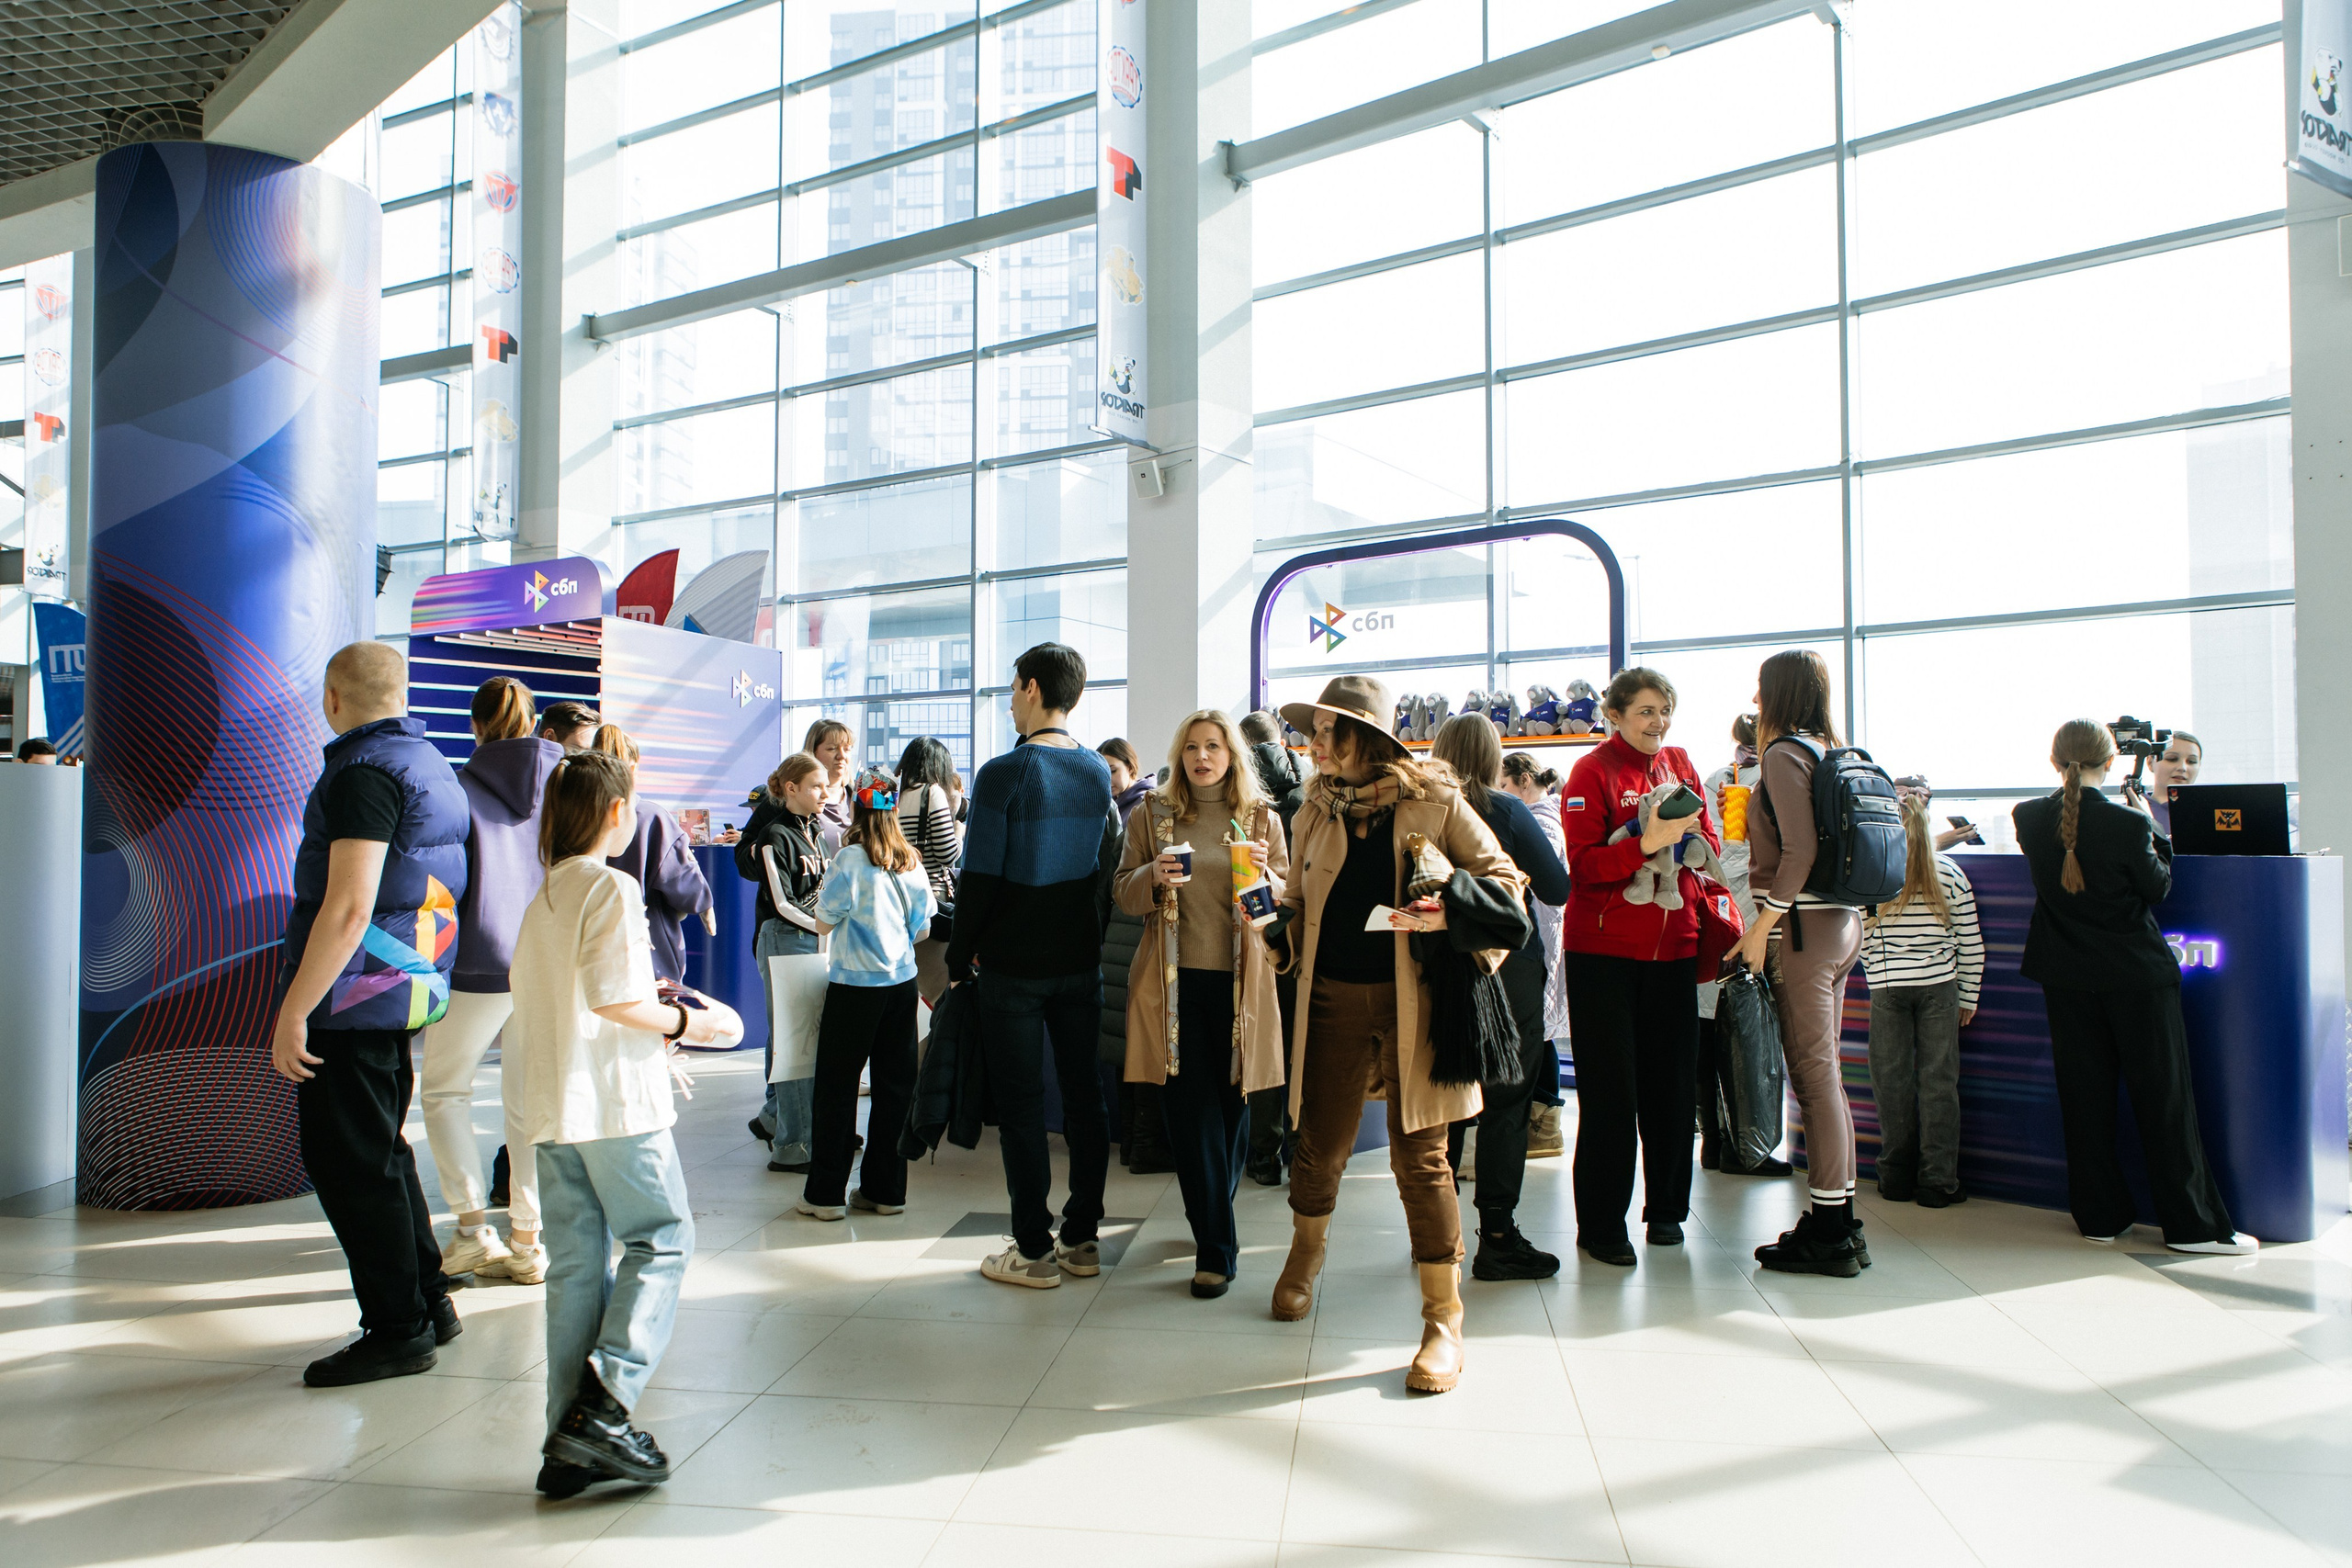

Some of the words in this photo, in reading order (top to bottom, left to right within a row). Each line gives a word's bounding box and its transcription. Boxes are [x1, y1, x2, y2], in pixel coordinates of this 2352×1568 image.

[550, 578, 578, 596] сбп
[1352, 611, 1394, 632] сбп
[753, 683, 774, 699] сбп
[2164, 935, 2212, 967] бп
